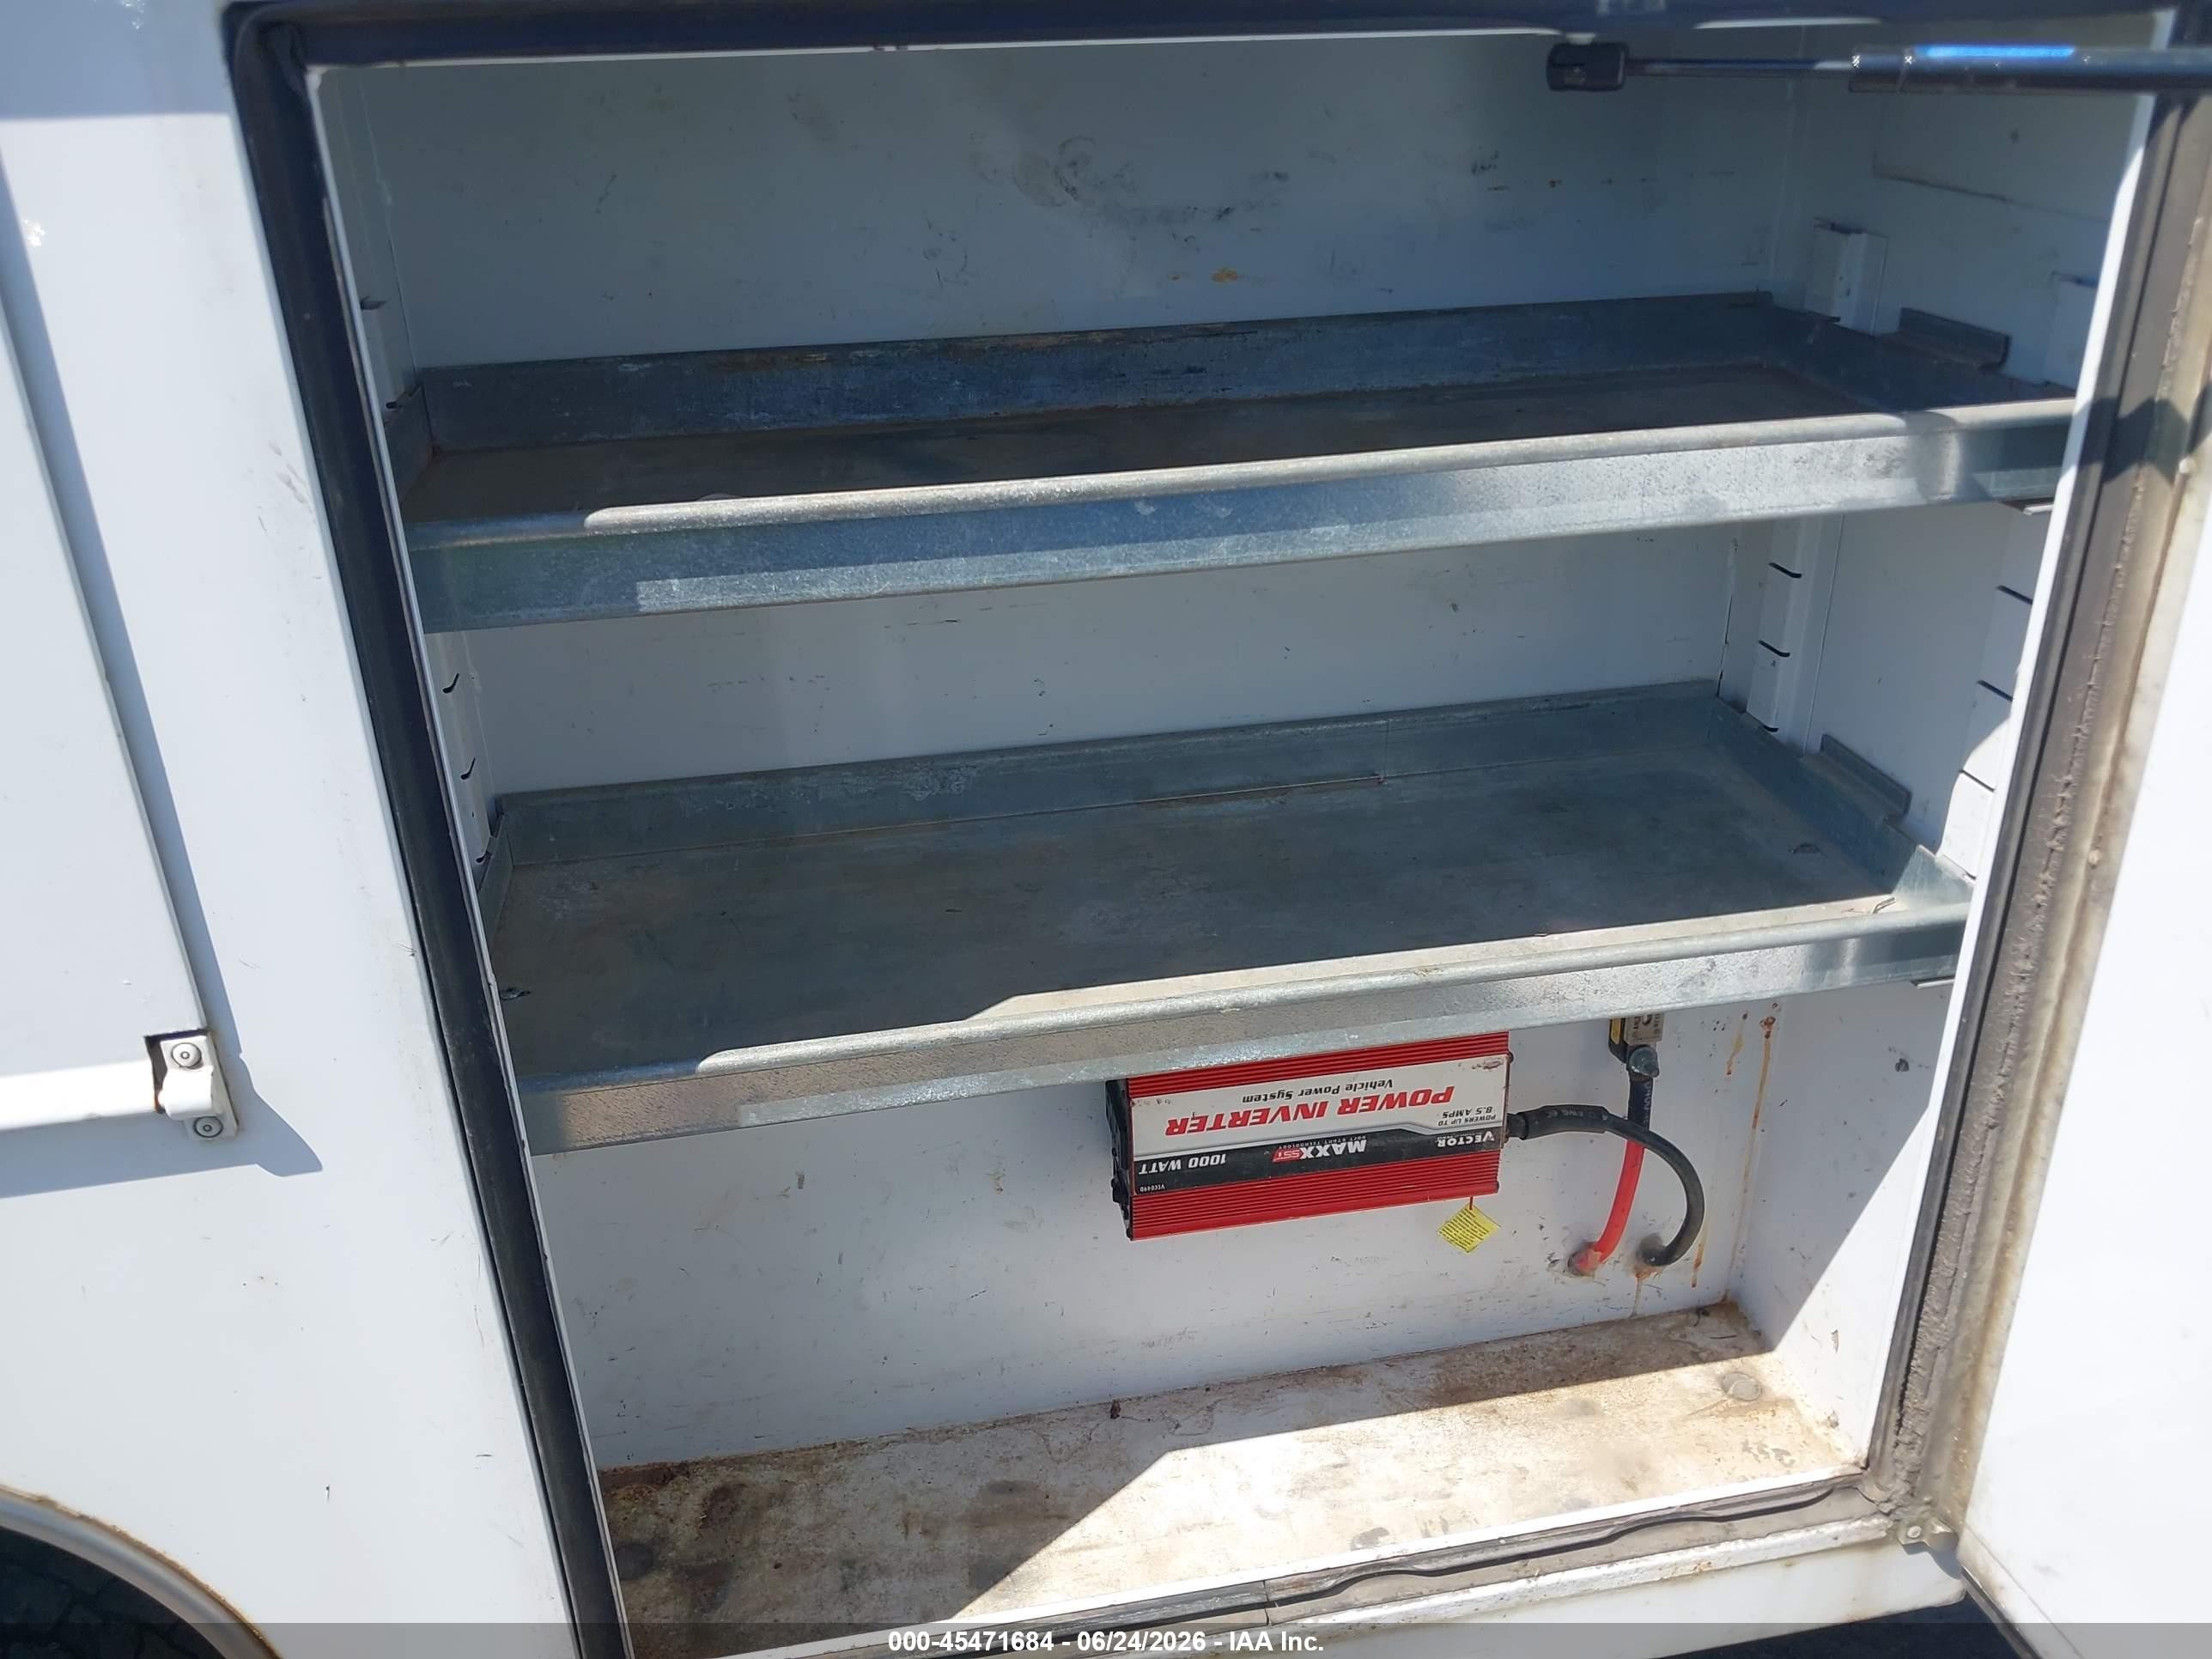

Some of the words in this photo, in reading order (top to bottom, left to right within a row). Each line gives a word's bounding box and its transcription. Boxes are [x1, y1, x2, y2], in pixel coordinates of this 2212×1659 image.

[1298, 1084, 1340, 1097] Power
[1344, 1079, 1394, 1092] Vehicle
[1242, 1090, 1294, 1103] System
[1337, 1085, 1455, 1115] POWER
[1442, 1108, 1473, 1119] AMPS
[1476, 1106, 1493, 1115] 8.5
[1165, 1101, 1329, 1136] INVERTER
[1464, 1114, 1497, 1123] POWERS
[1437, 1131, 1495, 1147] VECTOR
[1299, 1139, 1367, 1160] MAXX
[1139, 1159, 1182, 1175] WATT
[1188, 1153, 1226, 1169] 1000
